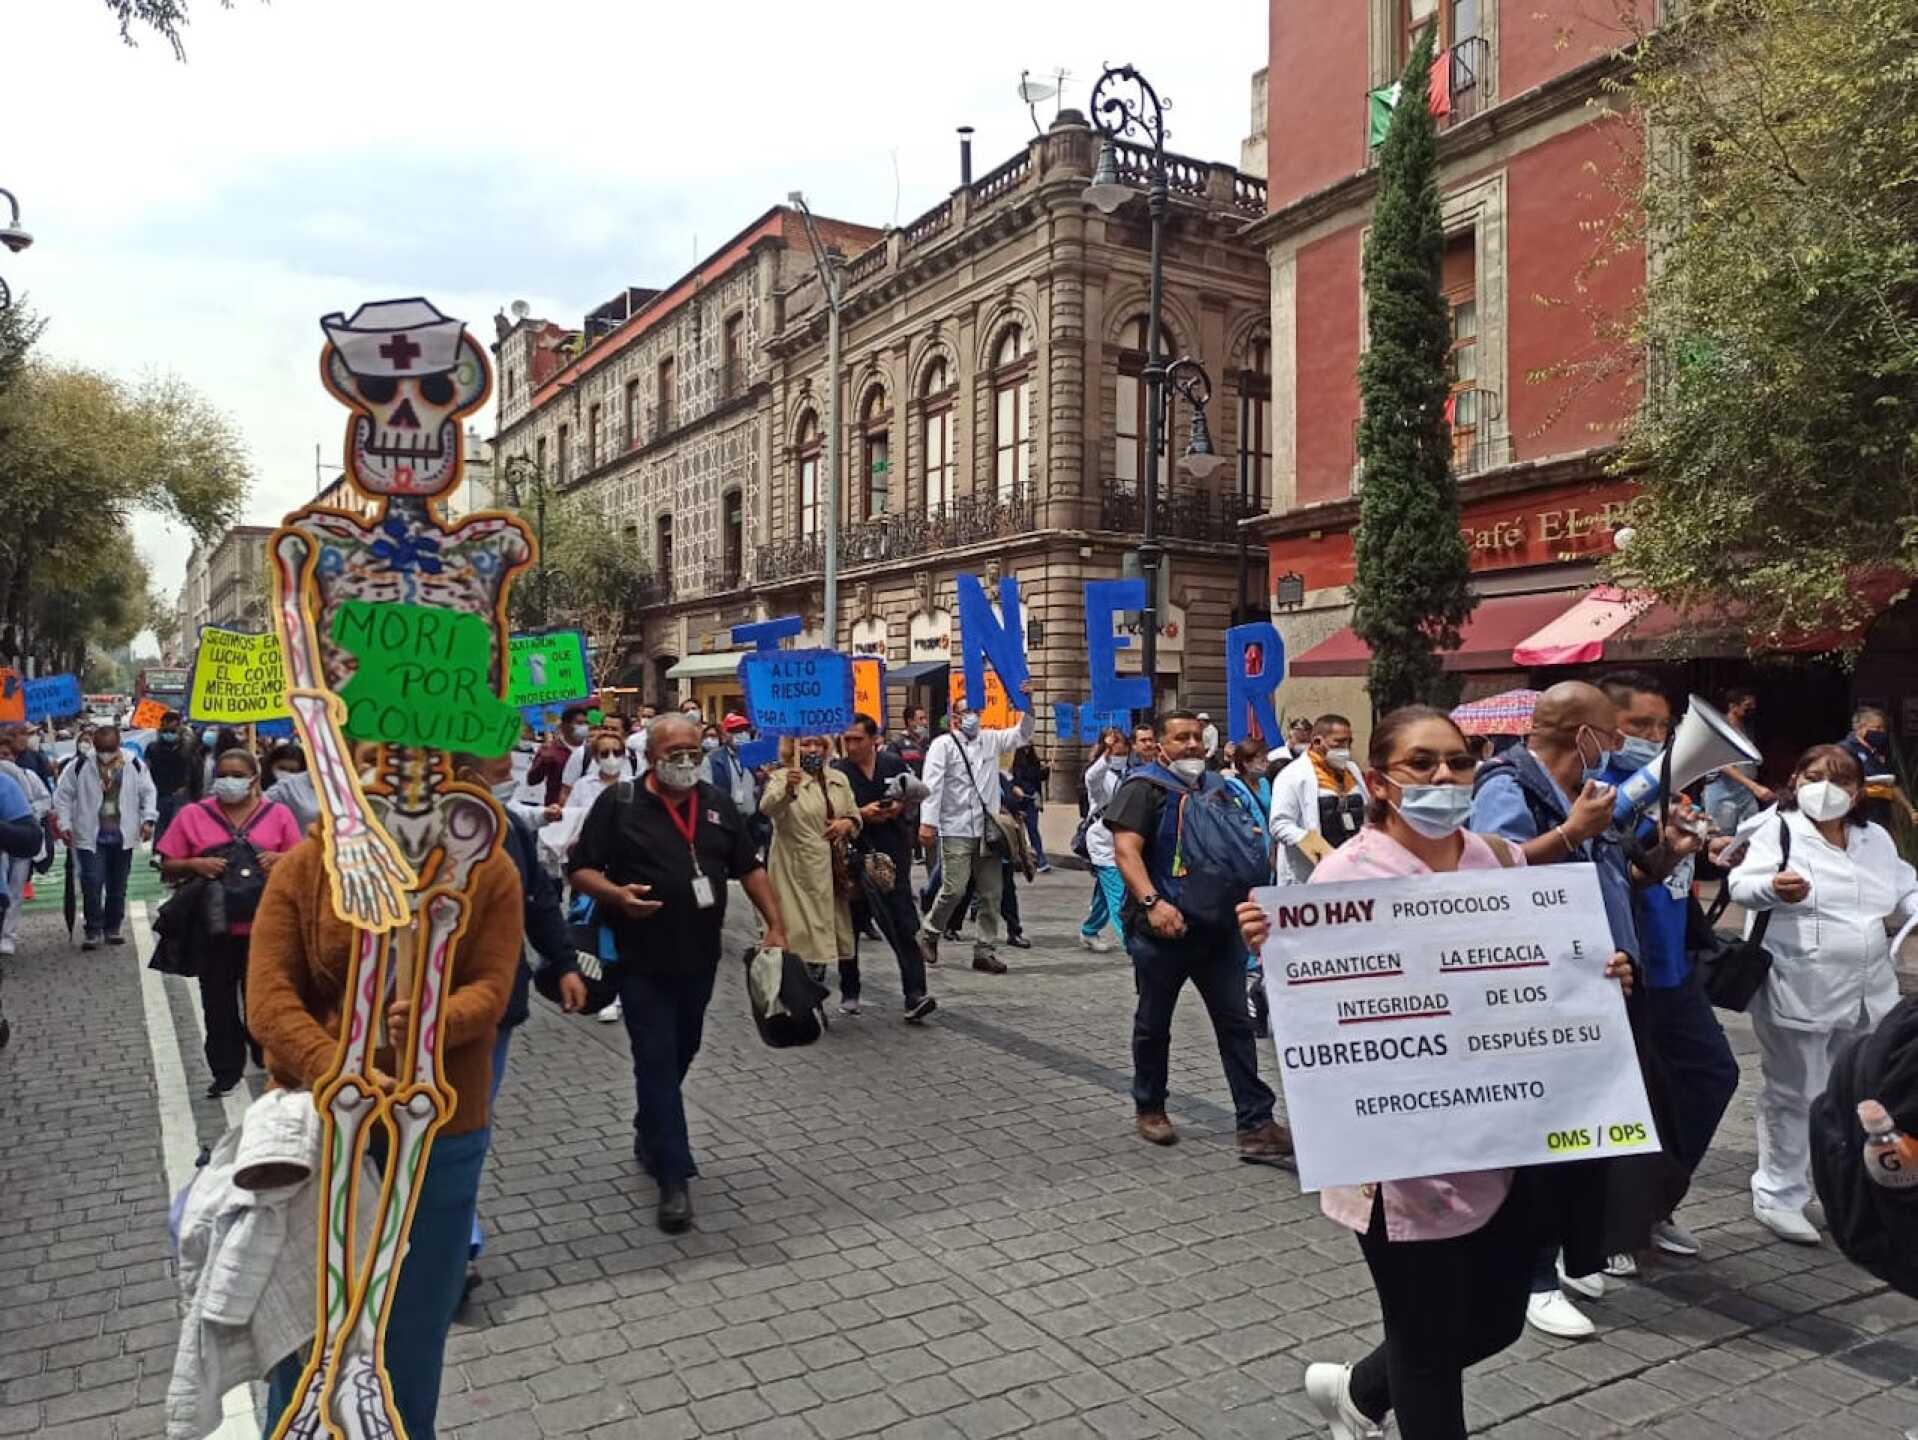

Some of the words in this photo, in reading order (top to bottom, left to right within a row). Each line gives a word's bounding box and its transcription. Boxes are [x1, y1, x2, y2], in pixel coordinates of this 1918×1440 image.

[1536, 508, 1591, 541] EL
[210, 648, 249, 666] LUCHA
[772, 660, 816, 678] ALTO
[216, 665, 230, 681] EL
[386, 662, 479, 704] POR
[203, 696, 222, 712] UN
[227, 696, 267, 712] BONO
[771, 681, 820, 700] RIESGO
[757, 709, 787, 726] PARA
[799, 706, 845, 726] TODOS
[1279, 902, 1319, 929] NO
[1325, 899, 1375, 924] HAY
[1393, 895, 1511, 918] PROTOCOLOS
[1532, 889, 1568, 908] QUE
[1286, 952, 1402, 979] GARANTICEN
[1440, 950, 1463, 967] LA
[1467, 944, 1546, 964] EFICACIA
[1572, 940, 1583, 956] E
[1337, 993, 1449, 1018] INTEGRIDAD
[1486, 989, 1511, 1006] DE
[1515, 986, 1548, 1004] LOS
[1284, 1034, 1448, 1069] CUBREBOCAS
[1468, 1028, 1548, 1052] DESPUÉS
[1553, 1027, 1574, 1045] DE
[1578, 1025, 1601, 1042] SU
[1355, 1080, 1546, 1117] REPROCESAMIENTO
[1547, 1127, 1592, 1150] OMS
[1608, 1122, 1647, 1143] OPS
